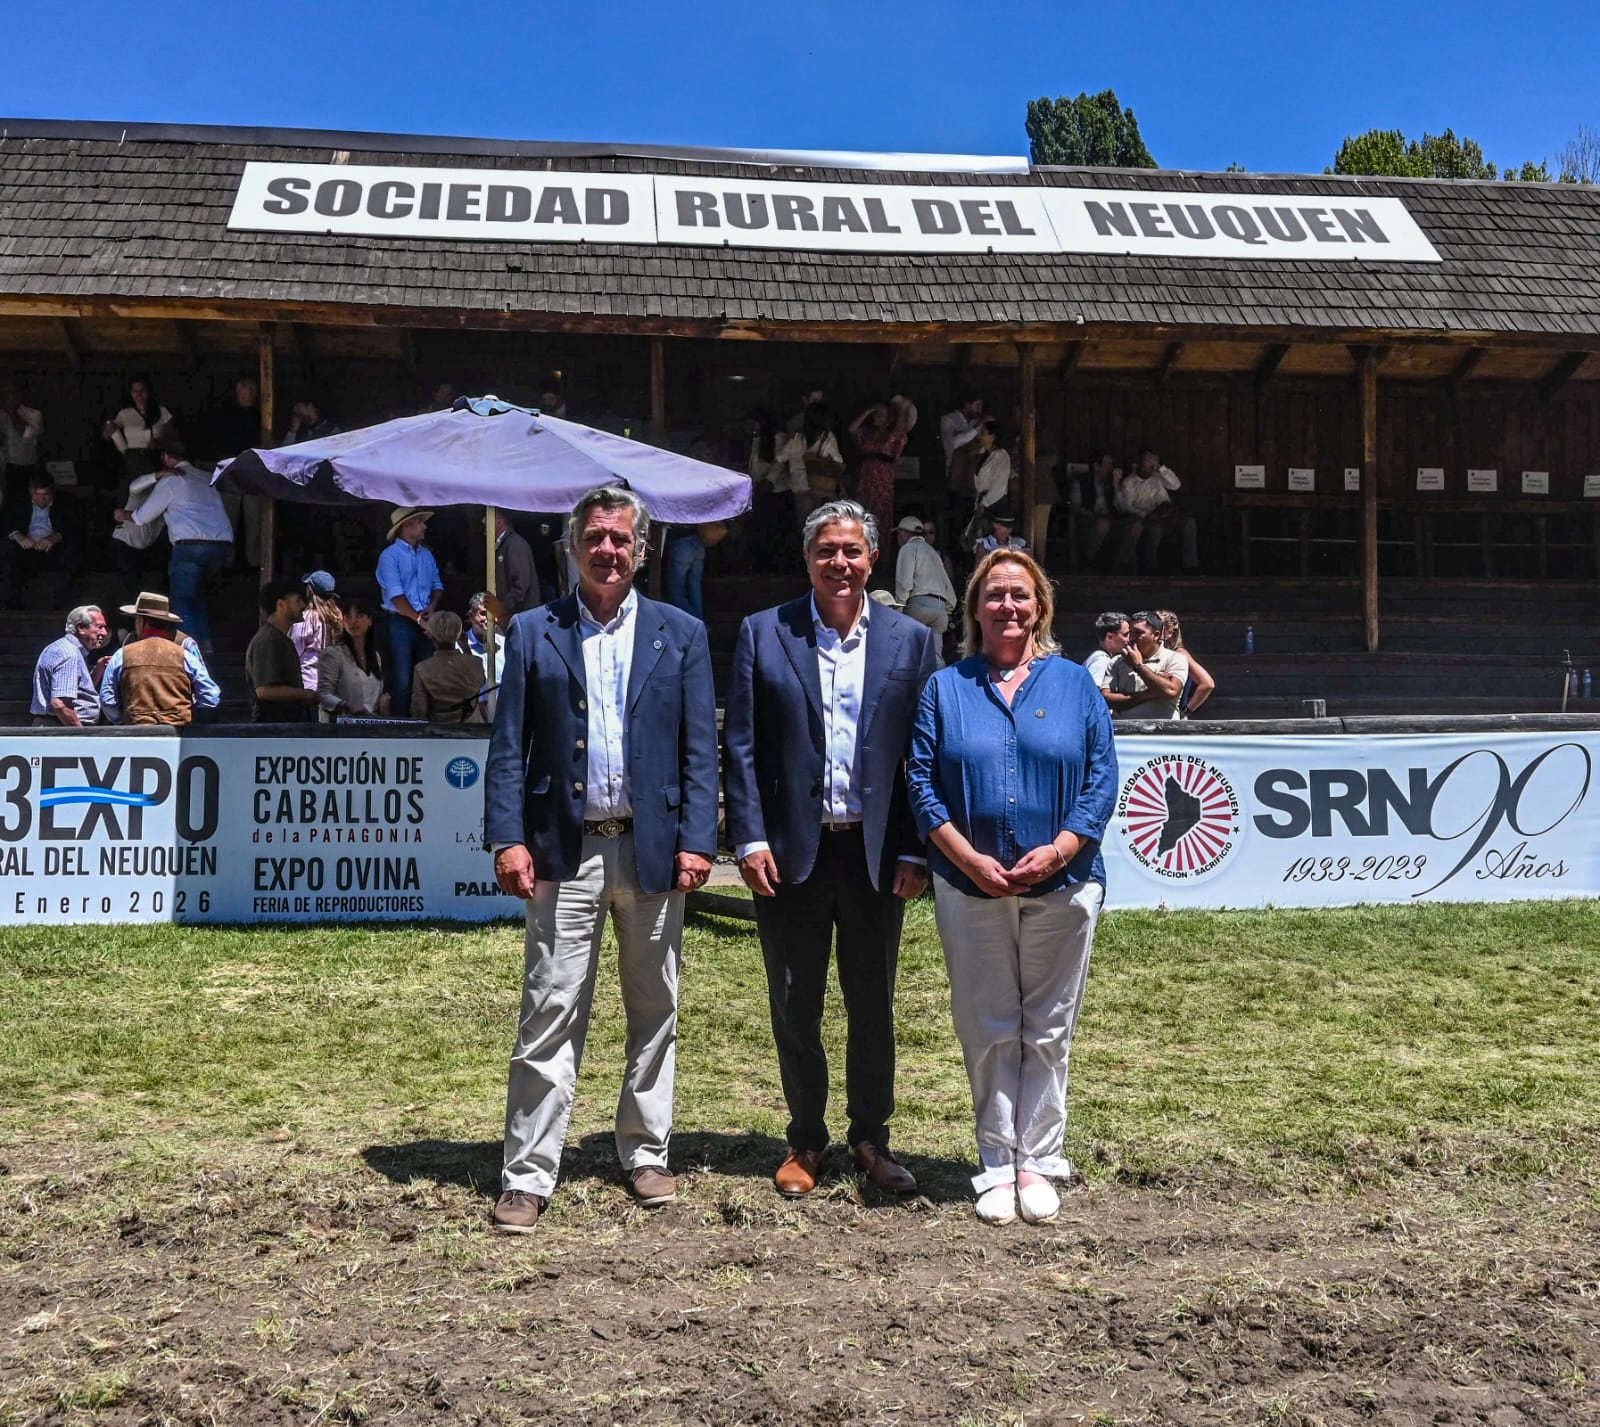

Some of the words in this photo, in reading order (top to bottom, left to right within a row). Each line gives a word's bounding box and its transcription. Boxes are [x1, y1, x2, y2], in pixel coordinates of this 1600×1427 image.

[263, 177, 629, 226] SOCIEDAD
[675, 190, 901, 234] RURAL
[912, 198, 1036, 237] DEL
[1084, 200, 1390, 246] NEUQUEN
[255, 751, 386, 785] EXPOSICIÓN
[396, 757, 423, 784] DE
[1118, 766, 1146, 818] SOCIEDAD
[1146, 754, 1184, 769] RURAL
[1187, 755, 1207, 769] DEL
[1208, 766, 1240, 816] NEUQUEN
[39, 755, 220, 842] EXPO
[253, 789, 424, 824] CABALLOS
[253, 829, 274, 843] de
[282, 829, 300, 843] la
[310, 829, 422, 843] PATAGONIA
[1253, 768, 1432, 839] SRN
[1412, 743, 1592, 898] 90
[44, 847, 90, 876] DEL
[99, 840, 217, 877] NEUQUÉN
[254, 857, 324, 891] EXPO
[336, 857, 420, 891] OVINA
[1128, 843, 1151, 867] UNION
[1155, 867, 1188, 878] ACCION
[1194, 841, 1233, 876] SACRIFICIO
[1282, 854, 1427, 882] 1933-2023
[1475, 841, 1569, 880] Años
[15, 891, 111, 914] Enero
[129, 891, 211, 913] 2026
[253, 897, 289, 913] FERIA
[294, 897, 310, 912] DE
[315, 897, 424, 913] REPRODUCTORES
